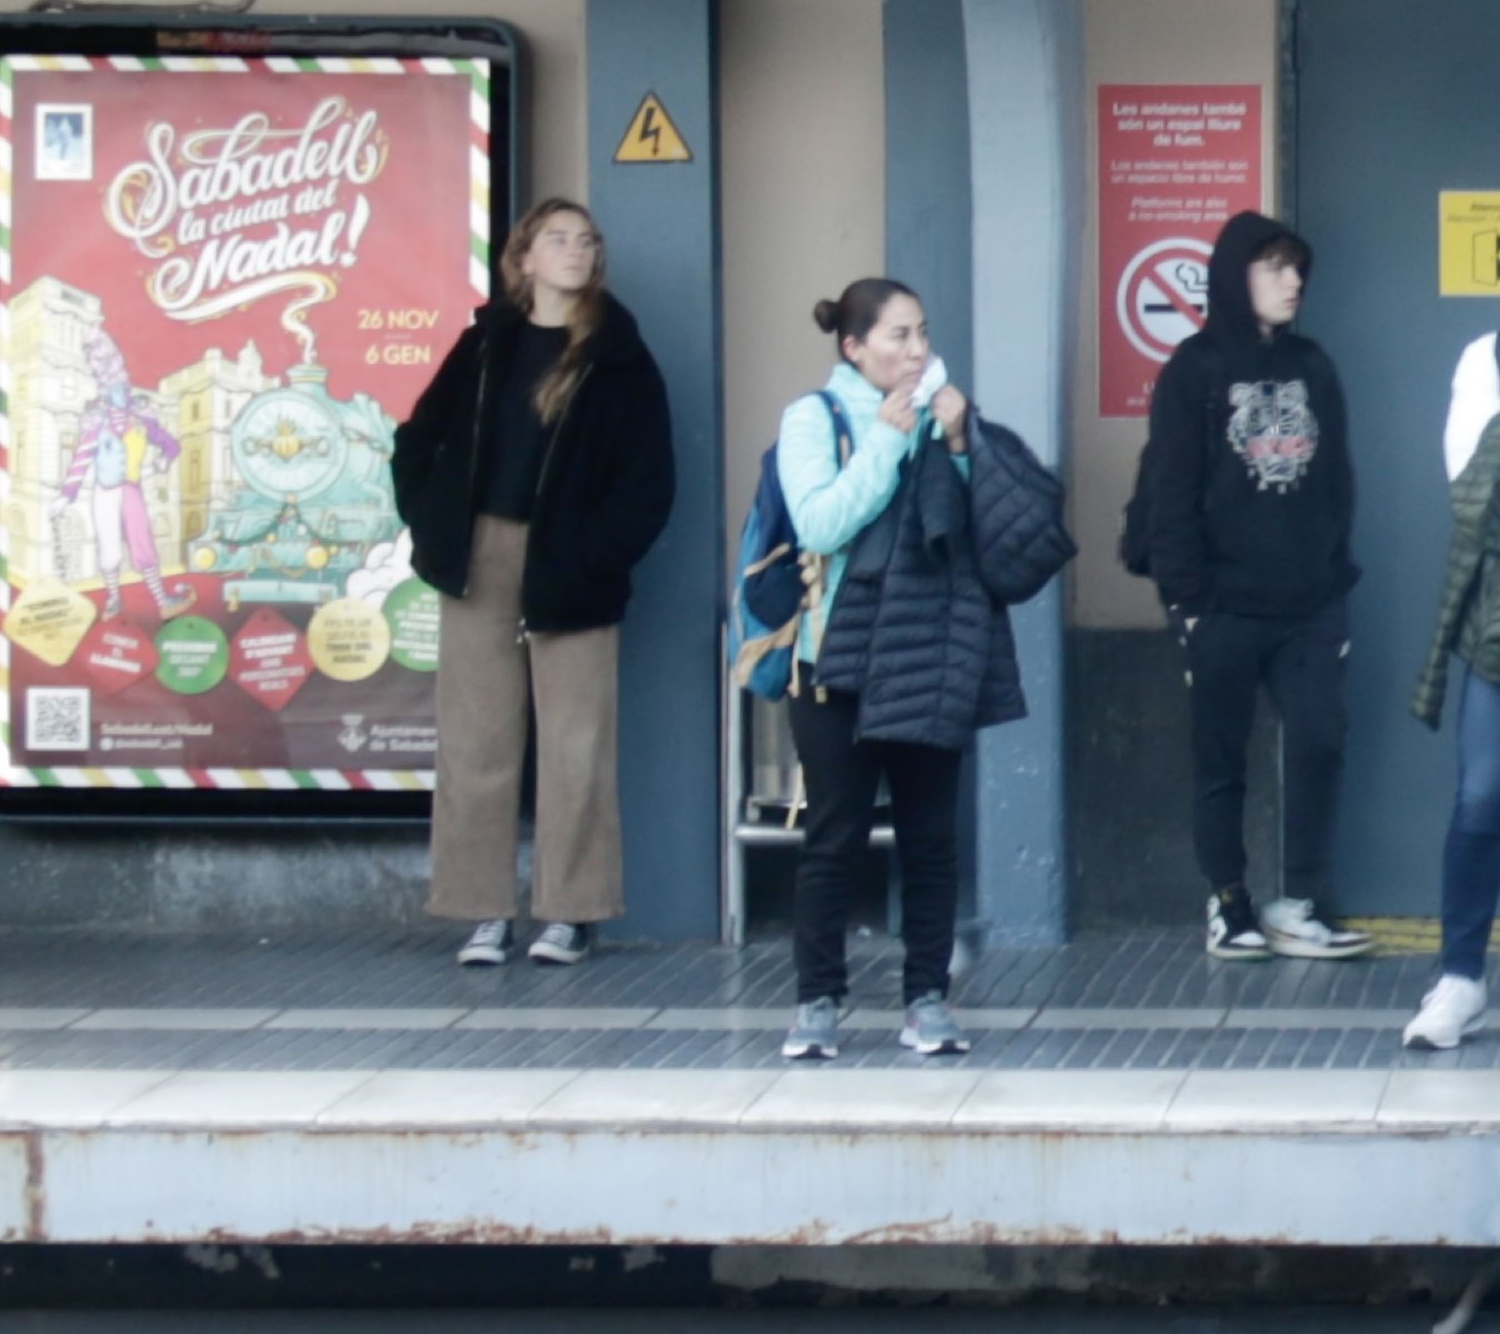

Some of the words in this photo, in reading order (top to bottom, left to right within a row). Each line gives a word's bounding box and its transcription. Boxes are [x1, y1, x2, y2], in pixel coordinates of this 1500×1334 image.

[1140, 101, 1199, 116] andanes
[1146, 121, 1164, 131] un
[1153, 134, 1172, 147] de
[107, 95, 380, 259] Sabadell
[177, 210, 206, 245] la
[209, 194, 290, 234] ciutat
[294, 178, 339, 215] del
[154, 193, 371, 312] Nadal!
[357, 308, 383, 330] 26
[388, 308, 439, 330] NOV
[366, 343, 379, 365] 6
[383, 343, 431, 365] GEN
[370, 723, 437, 738] Ajuntamen
